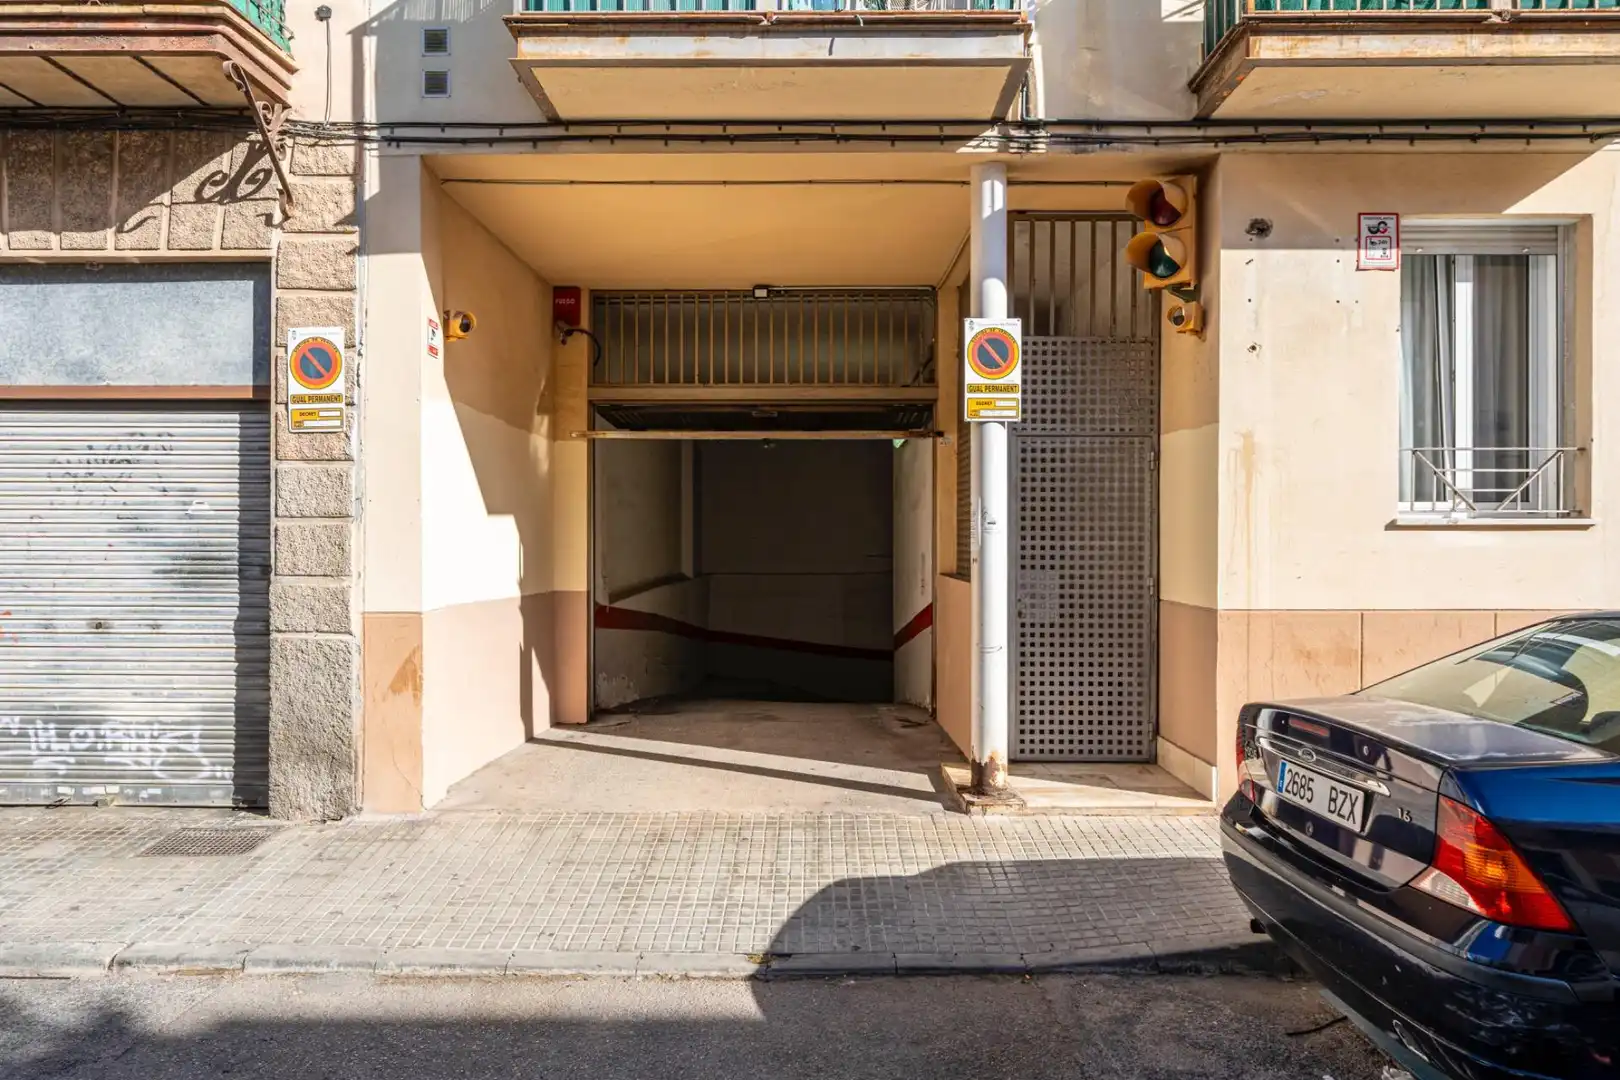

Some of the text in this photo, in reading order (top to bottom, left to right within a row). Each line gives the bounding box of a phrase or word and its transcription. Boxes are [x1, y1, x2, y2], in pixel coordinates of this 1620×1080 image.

[968, 385, 1017, 393] GUAL PERMANENT
[292, 395, 341, 403] GUAL PERMANENT
[1285, 768, 1359, 825] 2685 BZX
